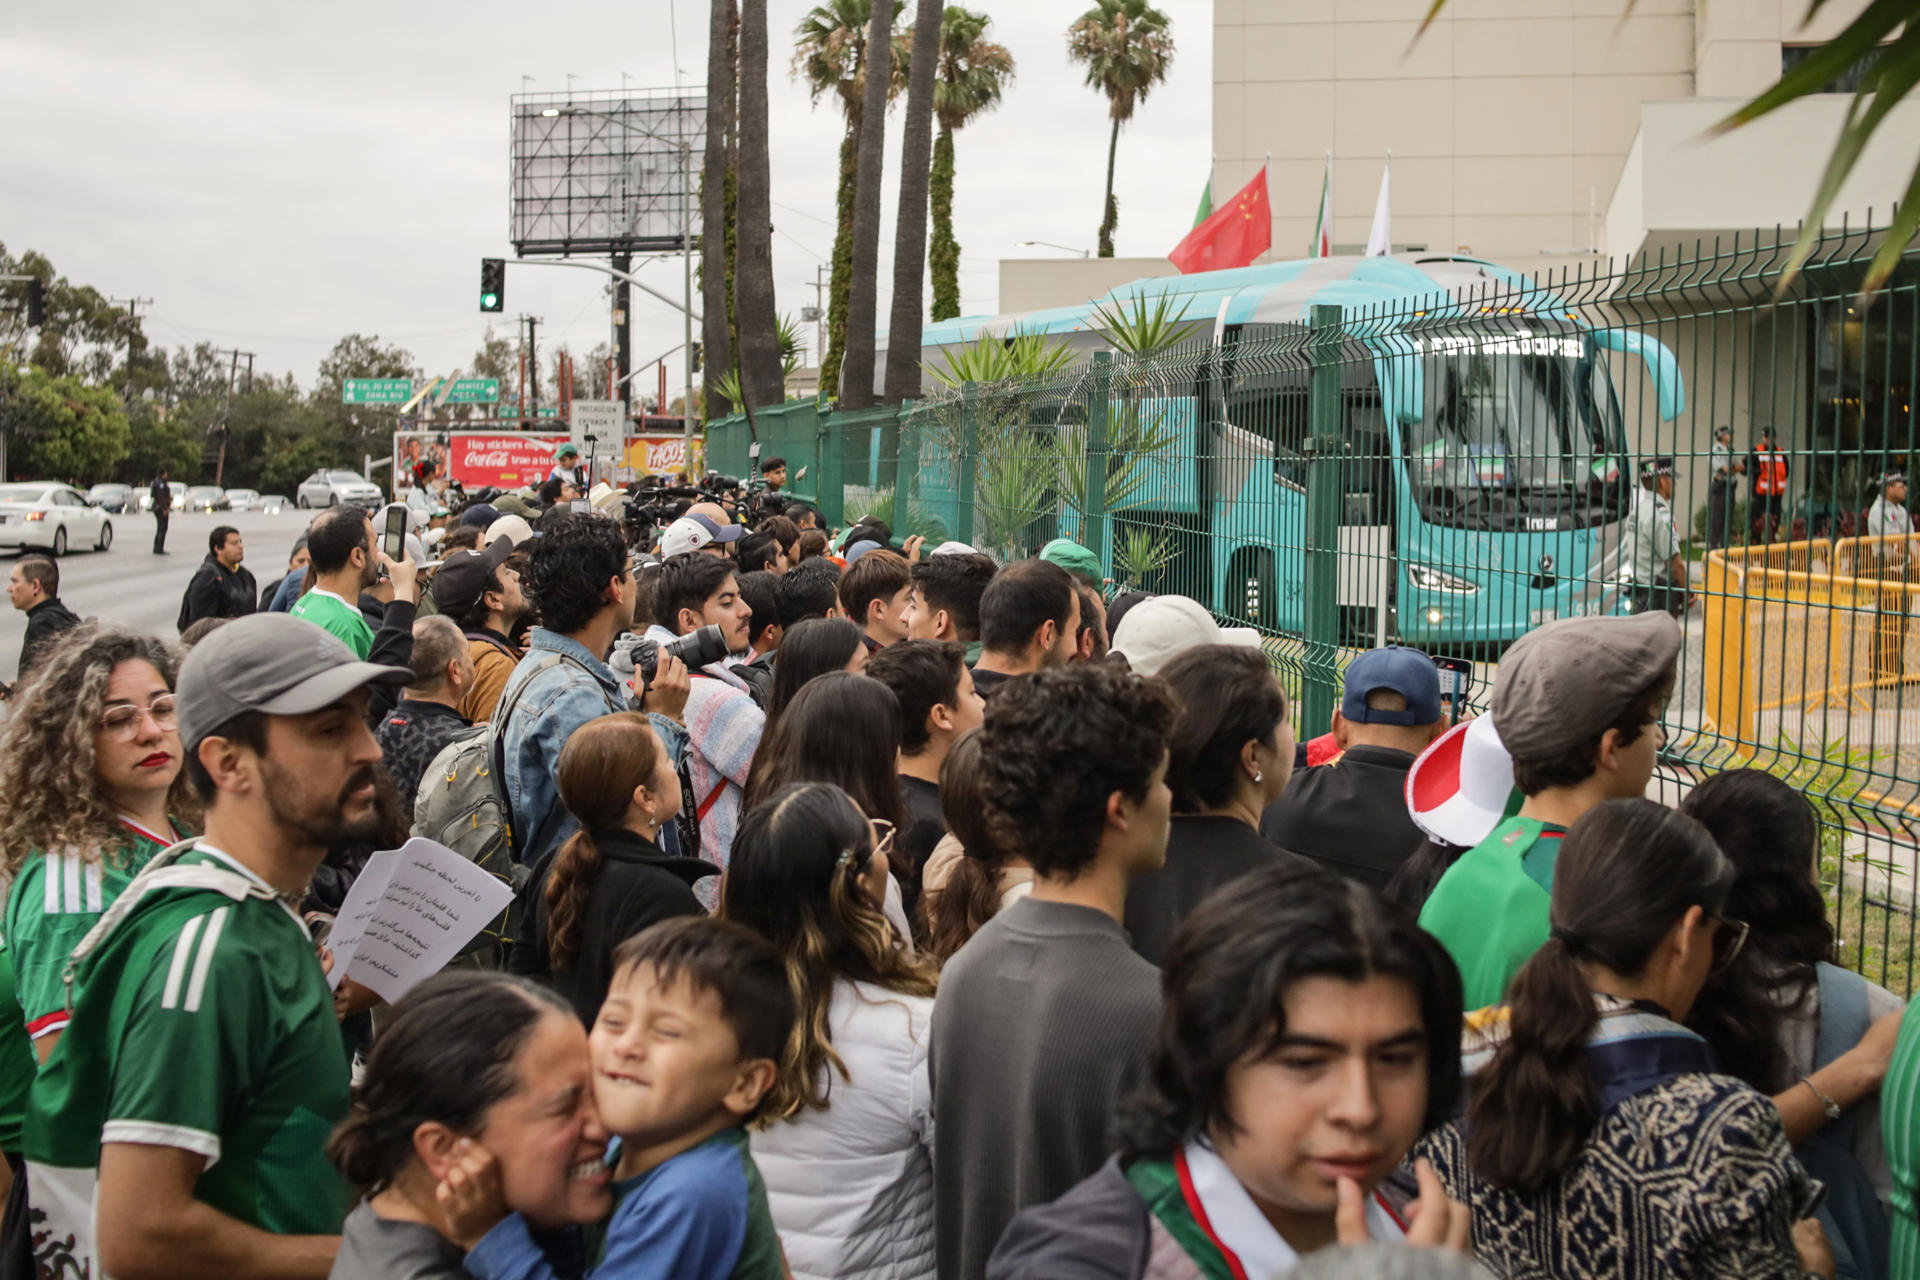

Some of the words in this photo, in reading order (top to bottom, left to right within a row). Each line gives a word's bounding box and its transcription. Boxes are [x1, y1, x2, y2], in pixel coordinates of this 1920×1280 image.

[1482, 336, 1530, 355] WORLD
[1532, 337, 1558, 355] CUP
[365, 391, 387, 400] ZONA
[389, 391, 404, 400] RIO
[578, 417, 608, 425] ENTRADA
[467, 439, 485, 451] Hay
[486, 439, 523, 450] stickers
[511, 455, 531, 465] trae
[532, 457, 538, 465] a
[539, 455, 550, 465] tu
[647, 441, 687, 470] TACOS
[683, 788, 694, 807] EOS
